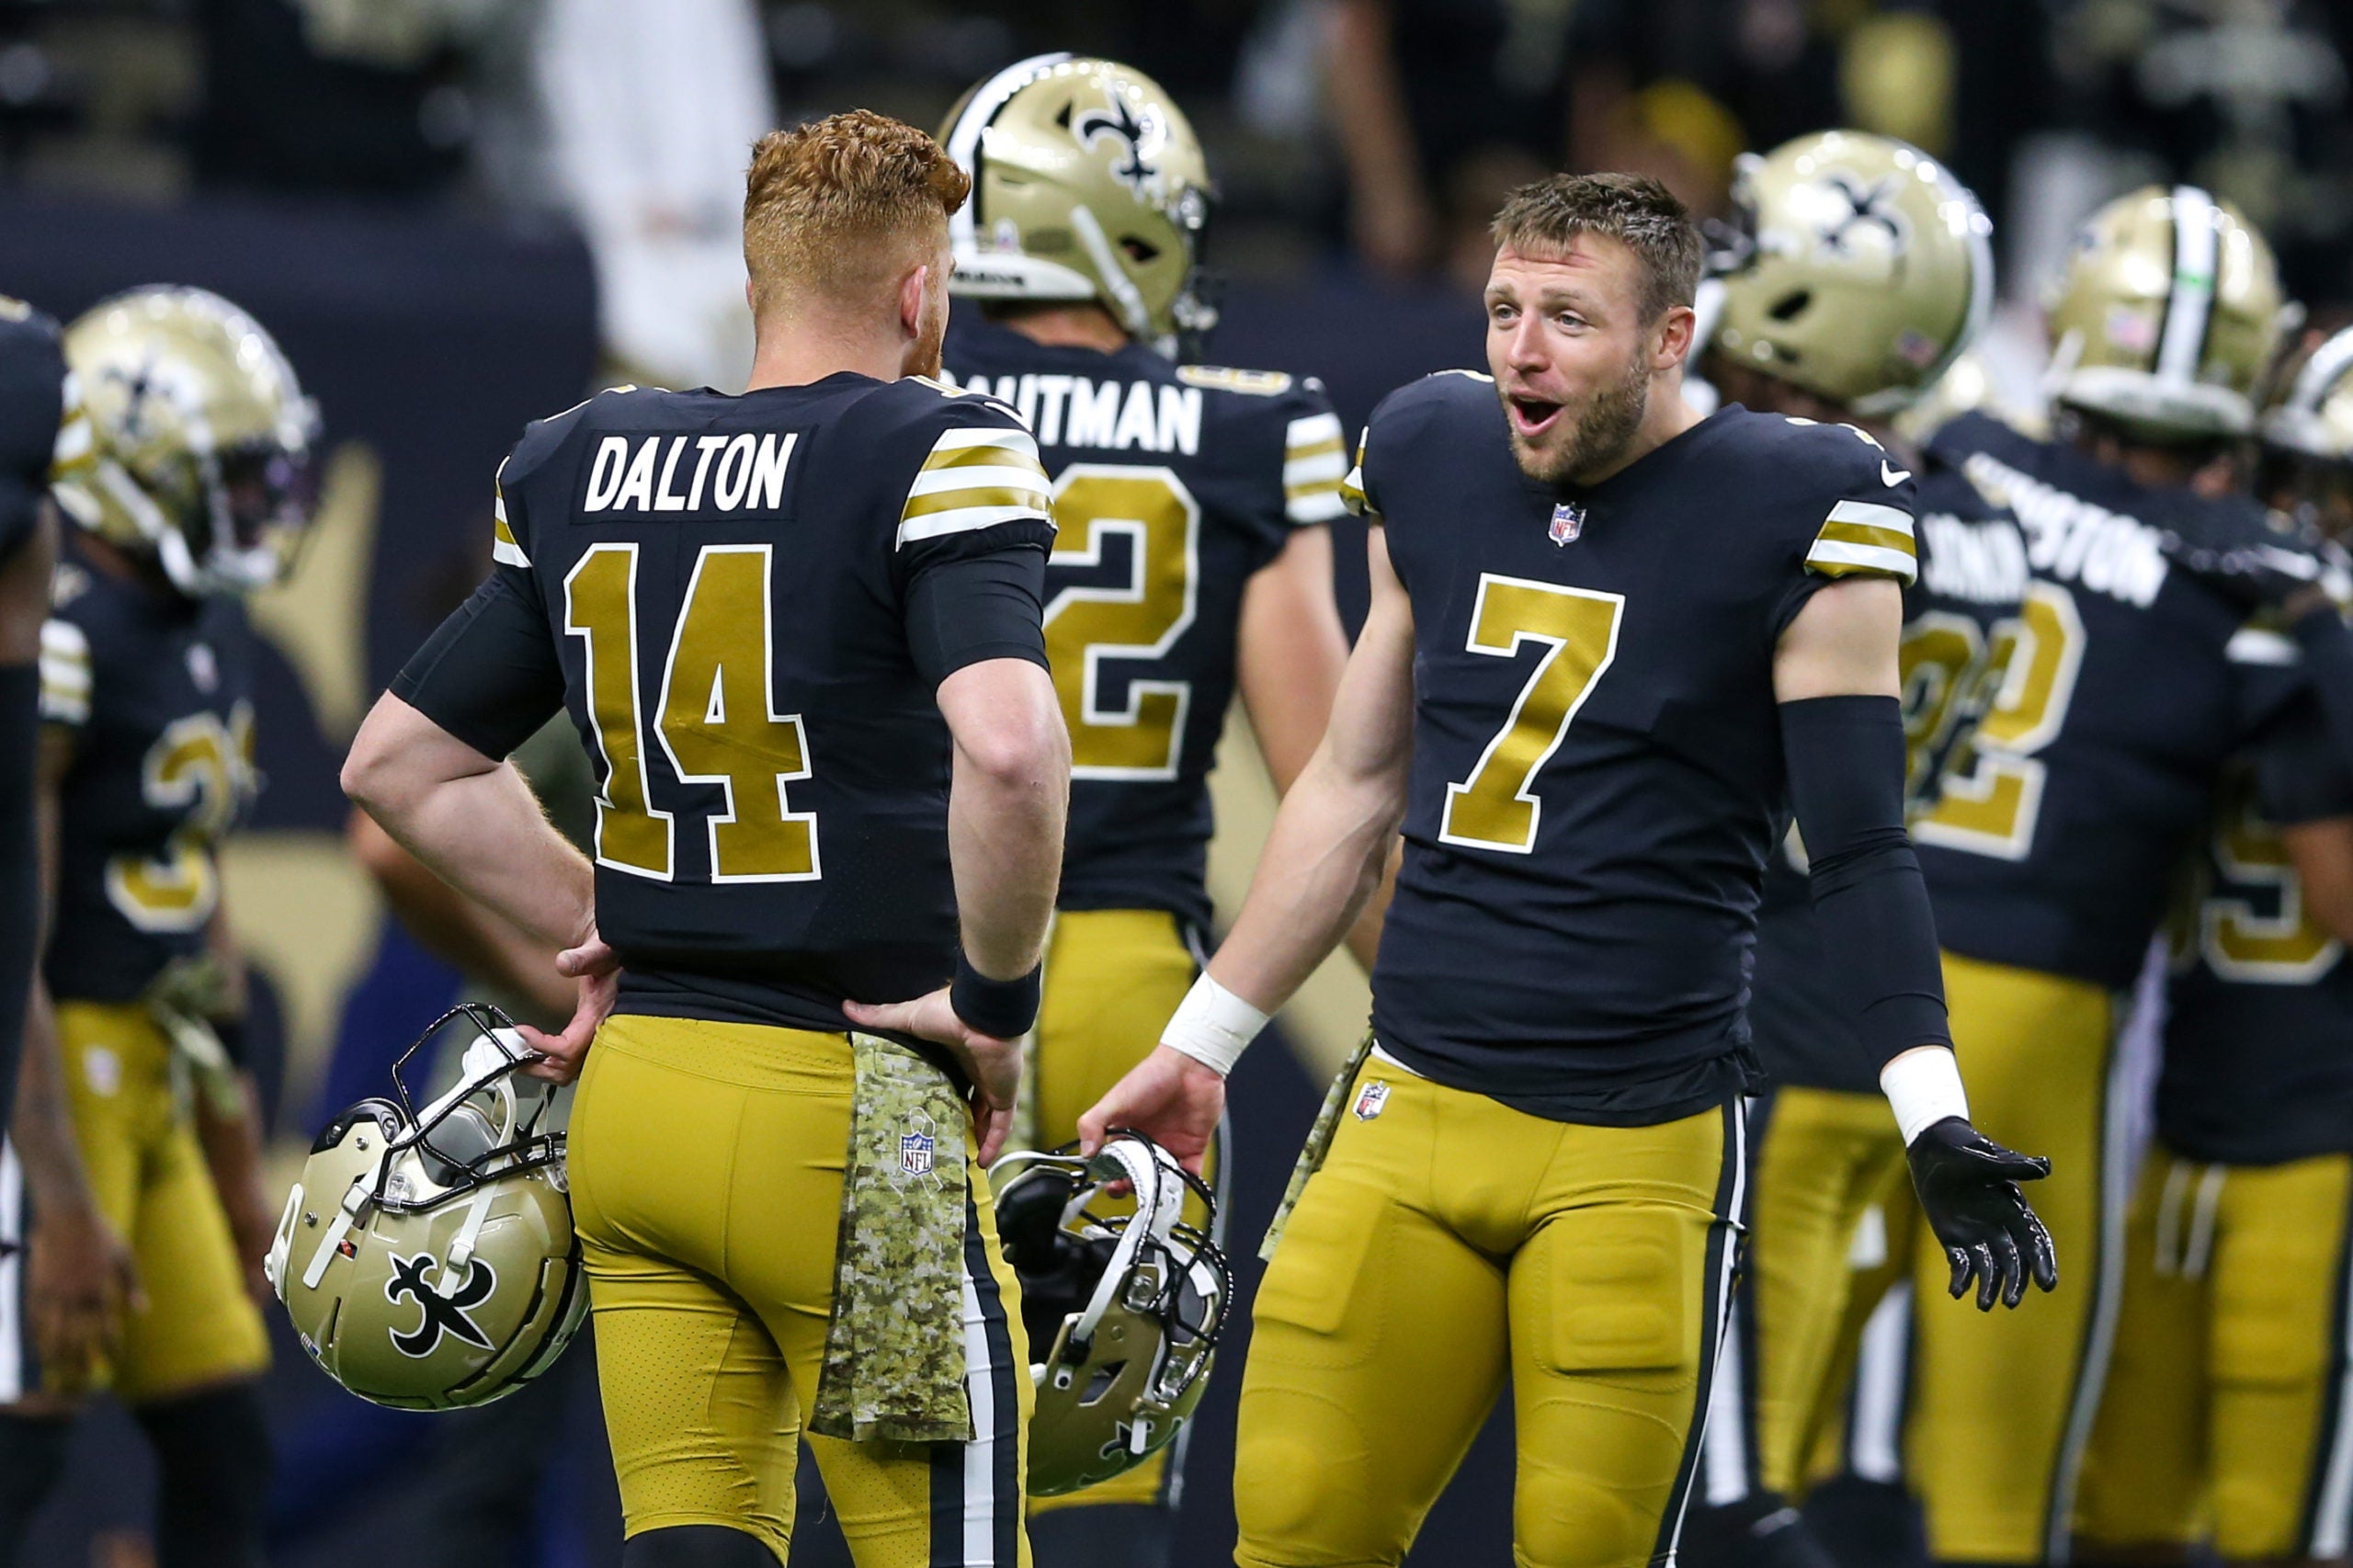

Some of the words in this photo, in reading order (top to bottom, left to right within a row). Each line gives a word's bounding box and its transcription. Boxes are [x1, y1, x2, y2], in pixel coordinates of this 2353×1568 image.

[939, 369, 1202, 456] UTMAN
[584, 433, 798, 512] DALTON
[563, 542, 822, 884] 14
[1438, 572, 1627, 854] 7
[904, 1152, 930, 1172] NFL
